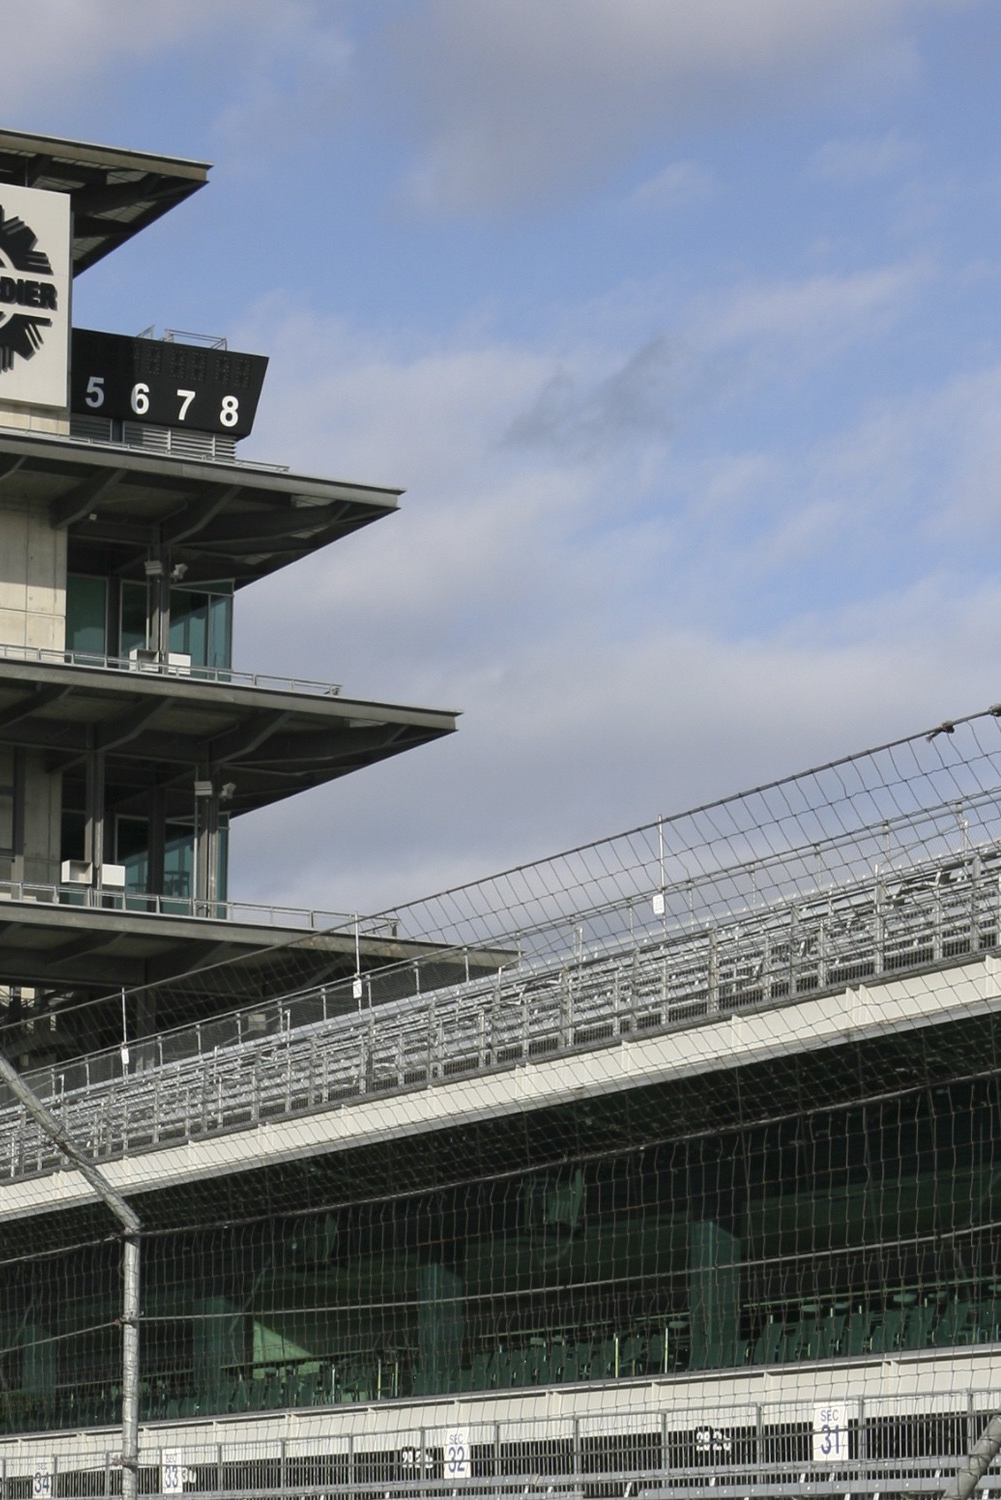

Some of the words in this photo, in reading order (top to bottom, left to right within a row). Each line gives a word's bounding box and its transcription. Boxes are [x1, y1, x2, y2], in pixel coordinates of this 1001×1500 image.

[85, 376, 105, 408] 5
[130, 382, 150, 415] 6
[176, 389, 196, 421] 7
[219, 395, 239, 427] 8
[820, 1409, 839, 1422] SEC
[449, 1433, 463, 1444] SEC
[821, 1424, 839, 1455] 31
[448, 1446, 465, 1473] 32
[34, 1472, 50, 1493] 34
[165, 1465, 178, 1488] 33
